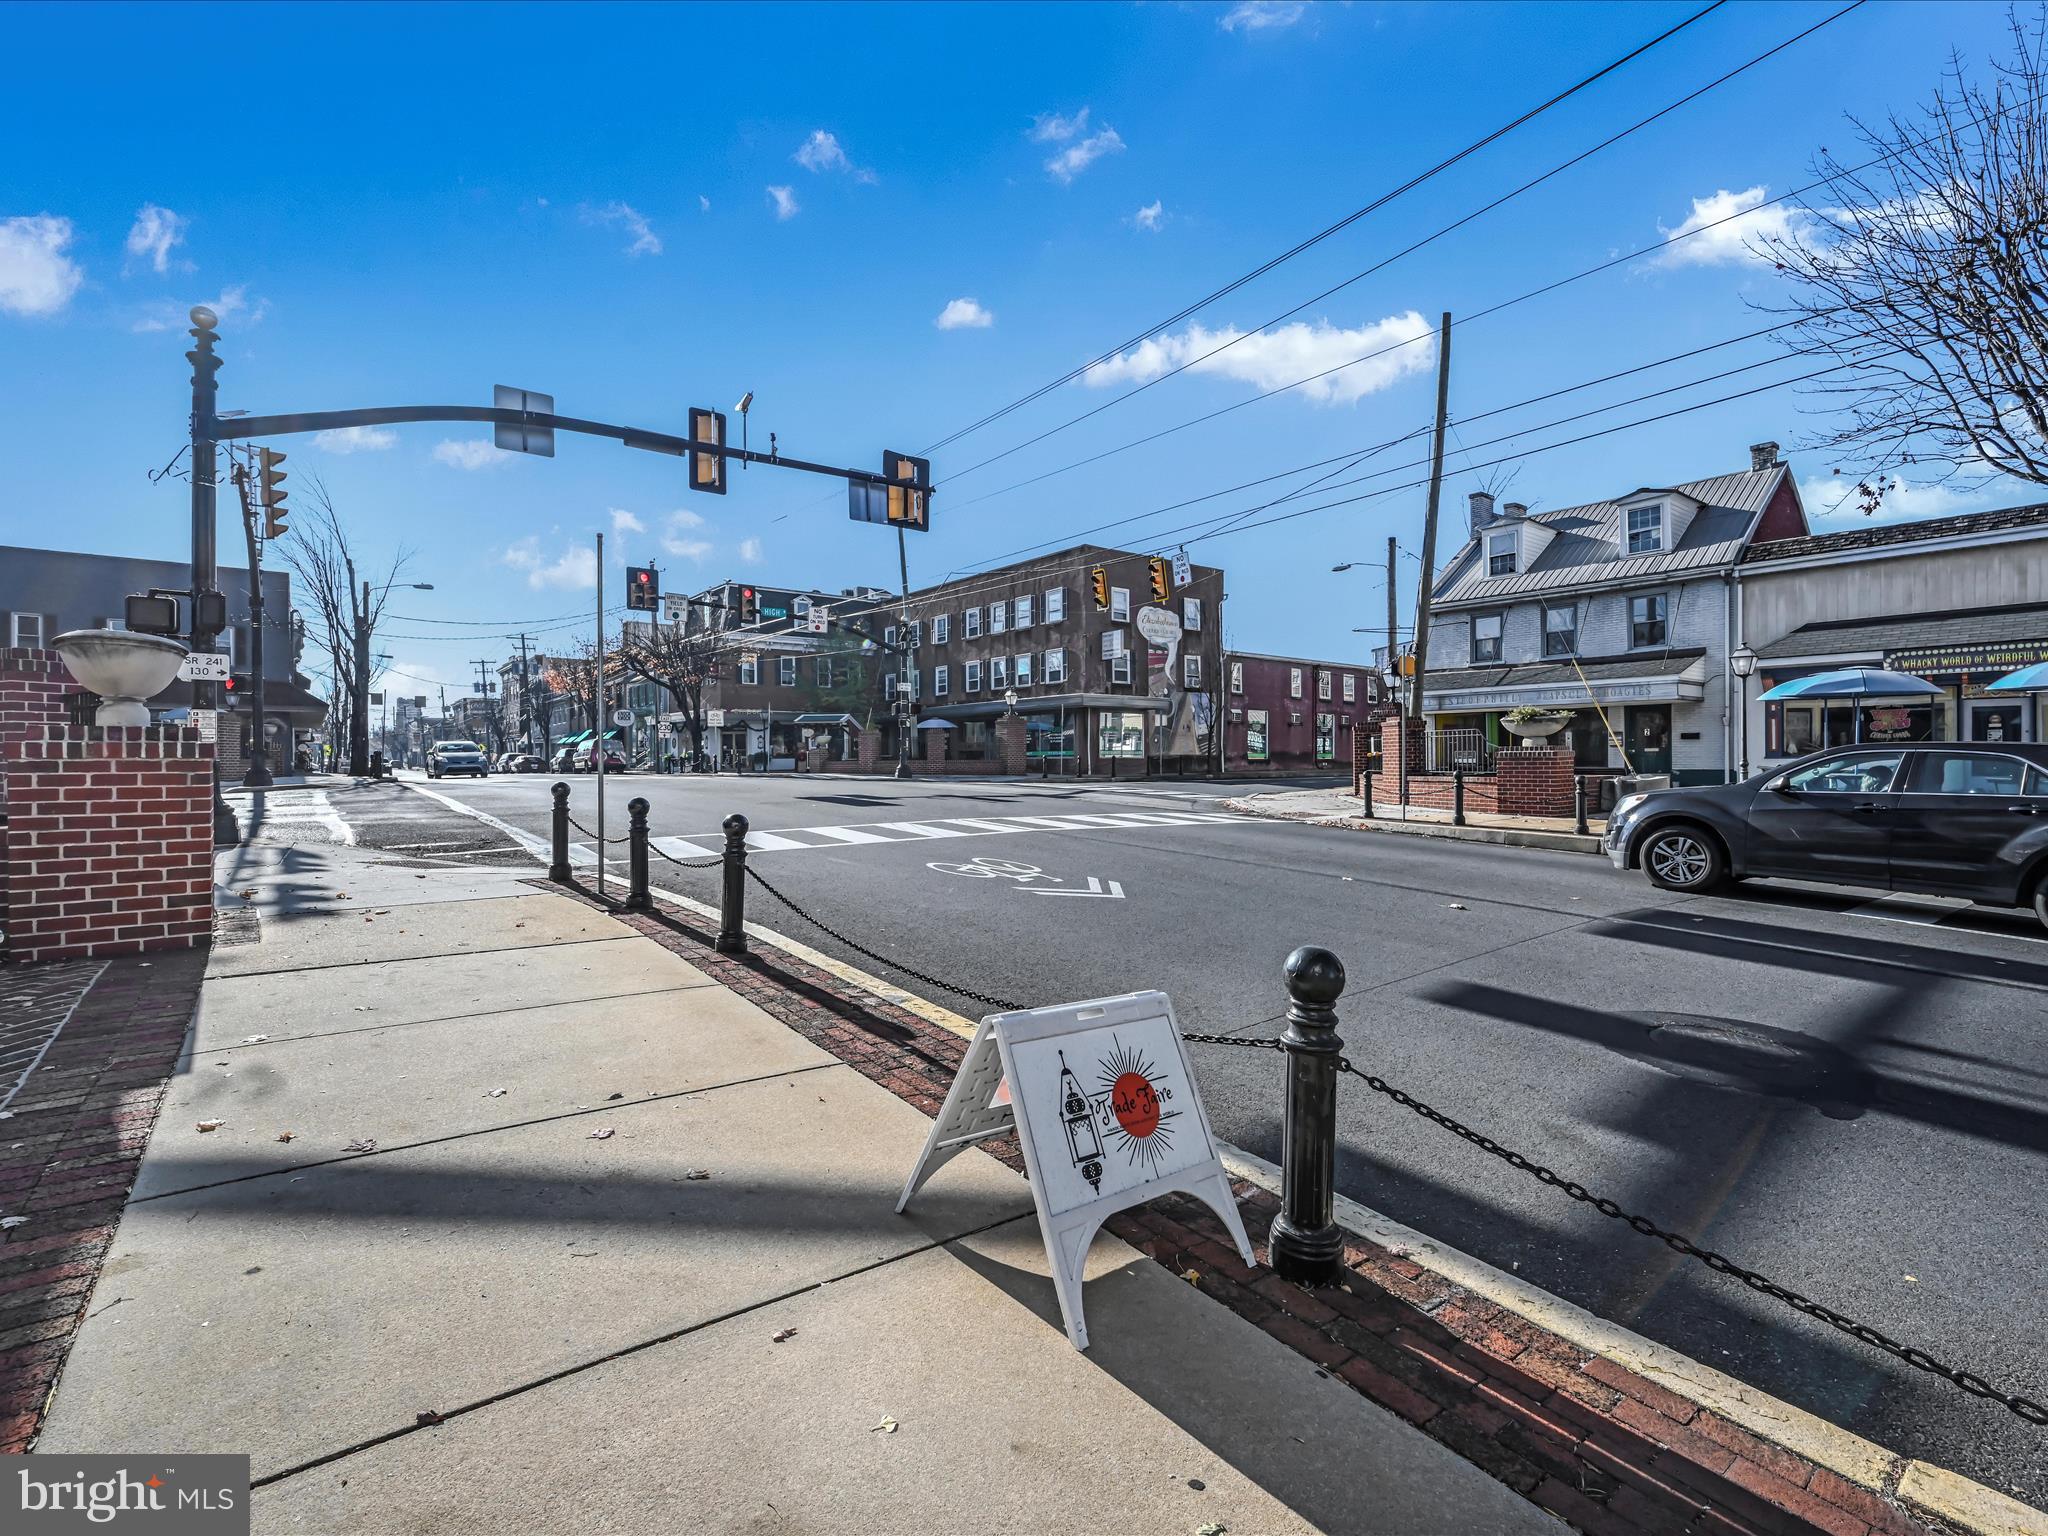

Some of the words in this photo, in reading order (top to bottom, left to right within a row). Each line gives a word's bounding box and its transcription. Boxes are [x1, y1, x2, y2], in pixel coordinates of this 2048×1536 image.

[185, 656, 199, 665] SR
[205, 657, 222, 665] 241
[1902, 657, 1938, 669] WHACKY
[1942, 655, 1972, 667] WORLD
[1974, 655, 1984, 664] OF
[1987, 651, 2036, 664] WEIRDFUL
[190, 667, 209, 675] 130
[1095, 1091, 1137, 1126] Trade
[1136, 1083, 1173, 1114] Faire
